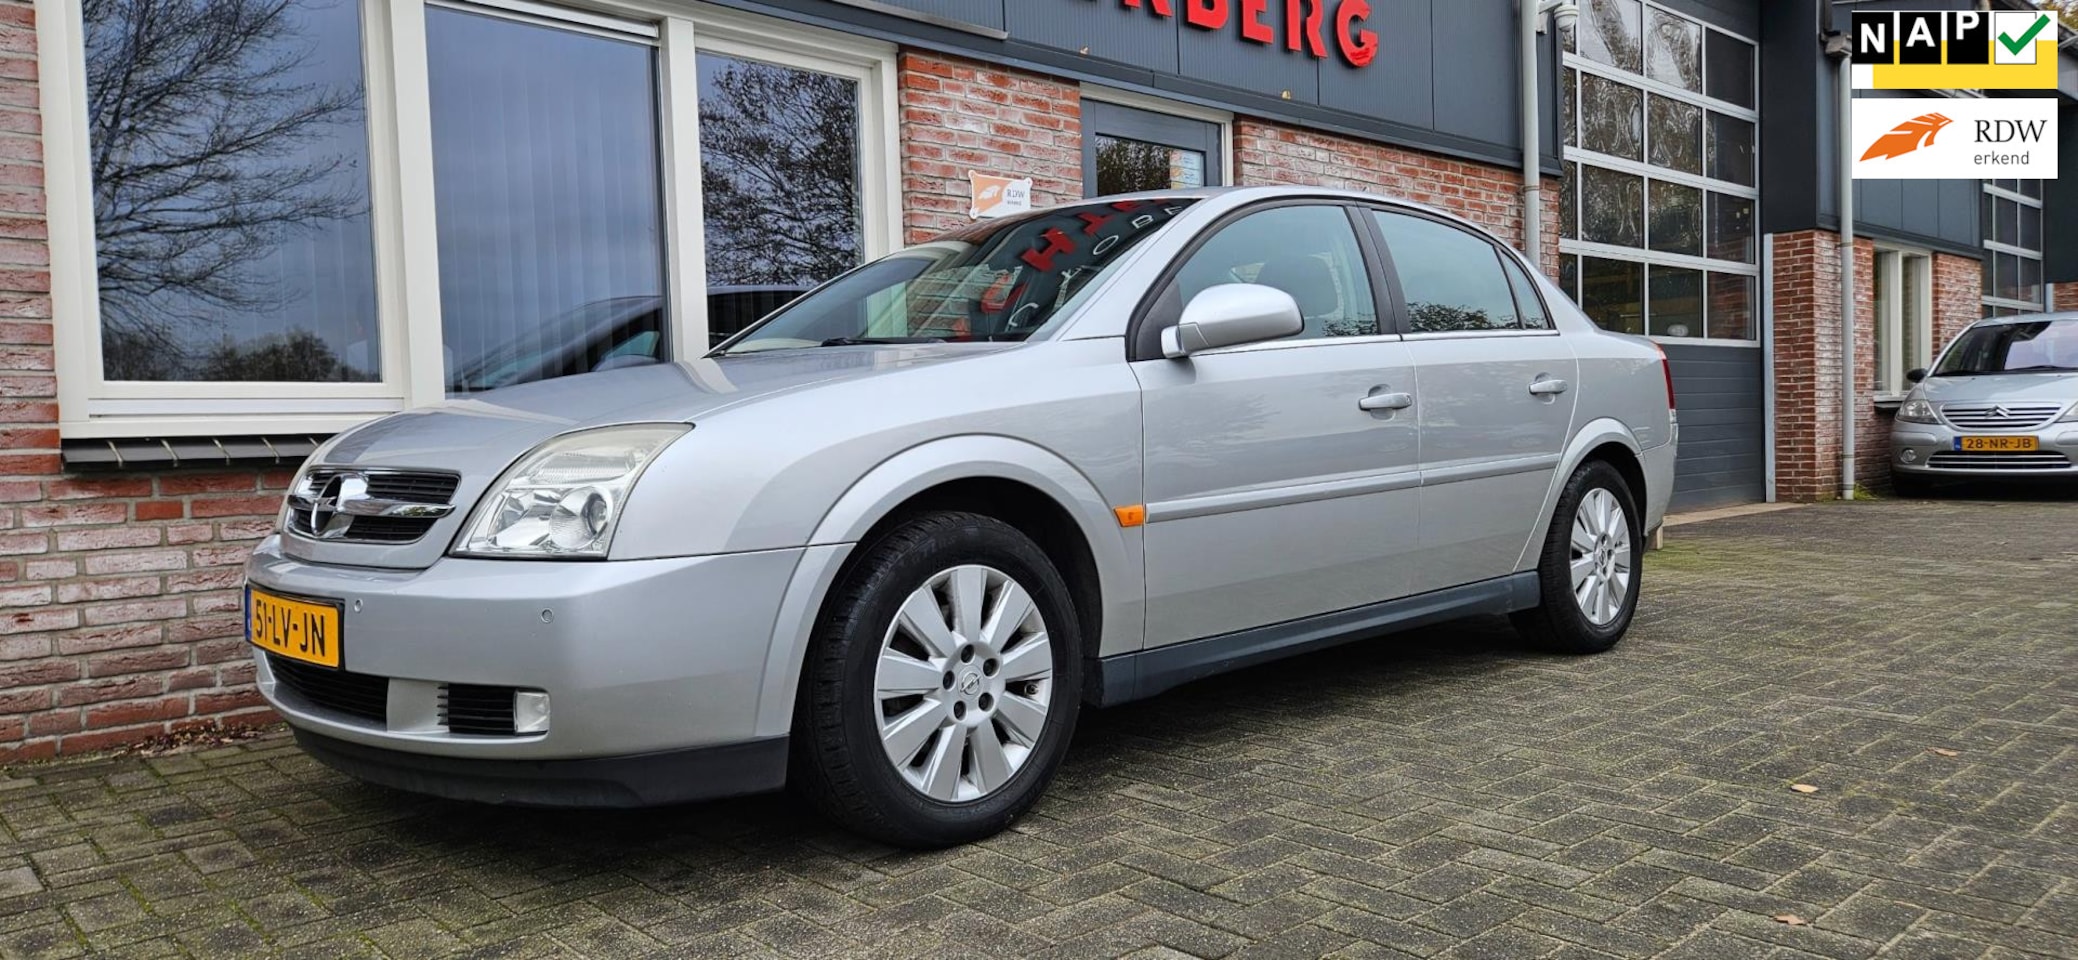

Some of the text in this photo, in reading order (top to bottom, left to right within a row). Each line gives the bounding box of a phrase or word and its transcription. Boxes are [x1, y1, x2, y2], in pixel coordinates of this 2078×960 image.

[1007, 188, 1025, 198] RDW
[1967, 438, 2032, 449] 28-NR-JB
[256, 599, 325, 657] 51-LV-JN
